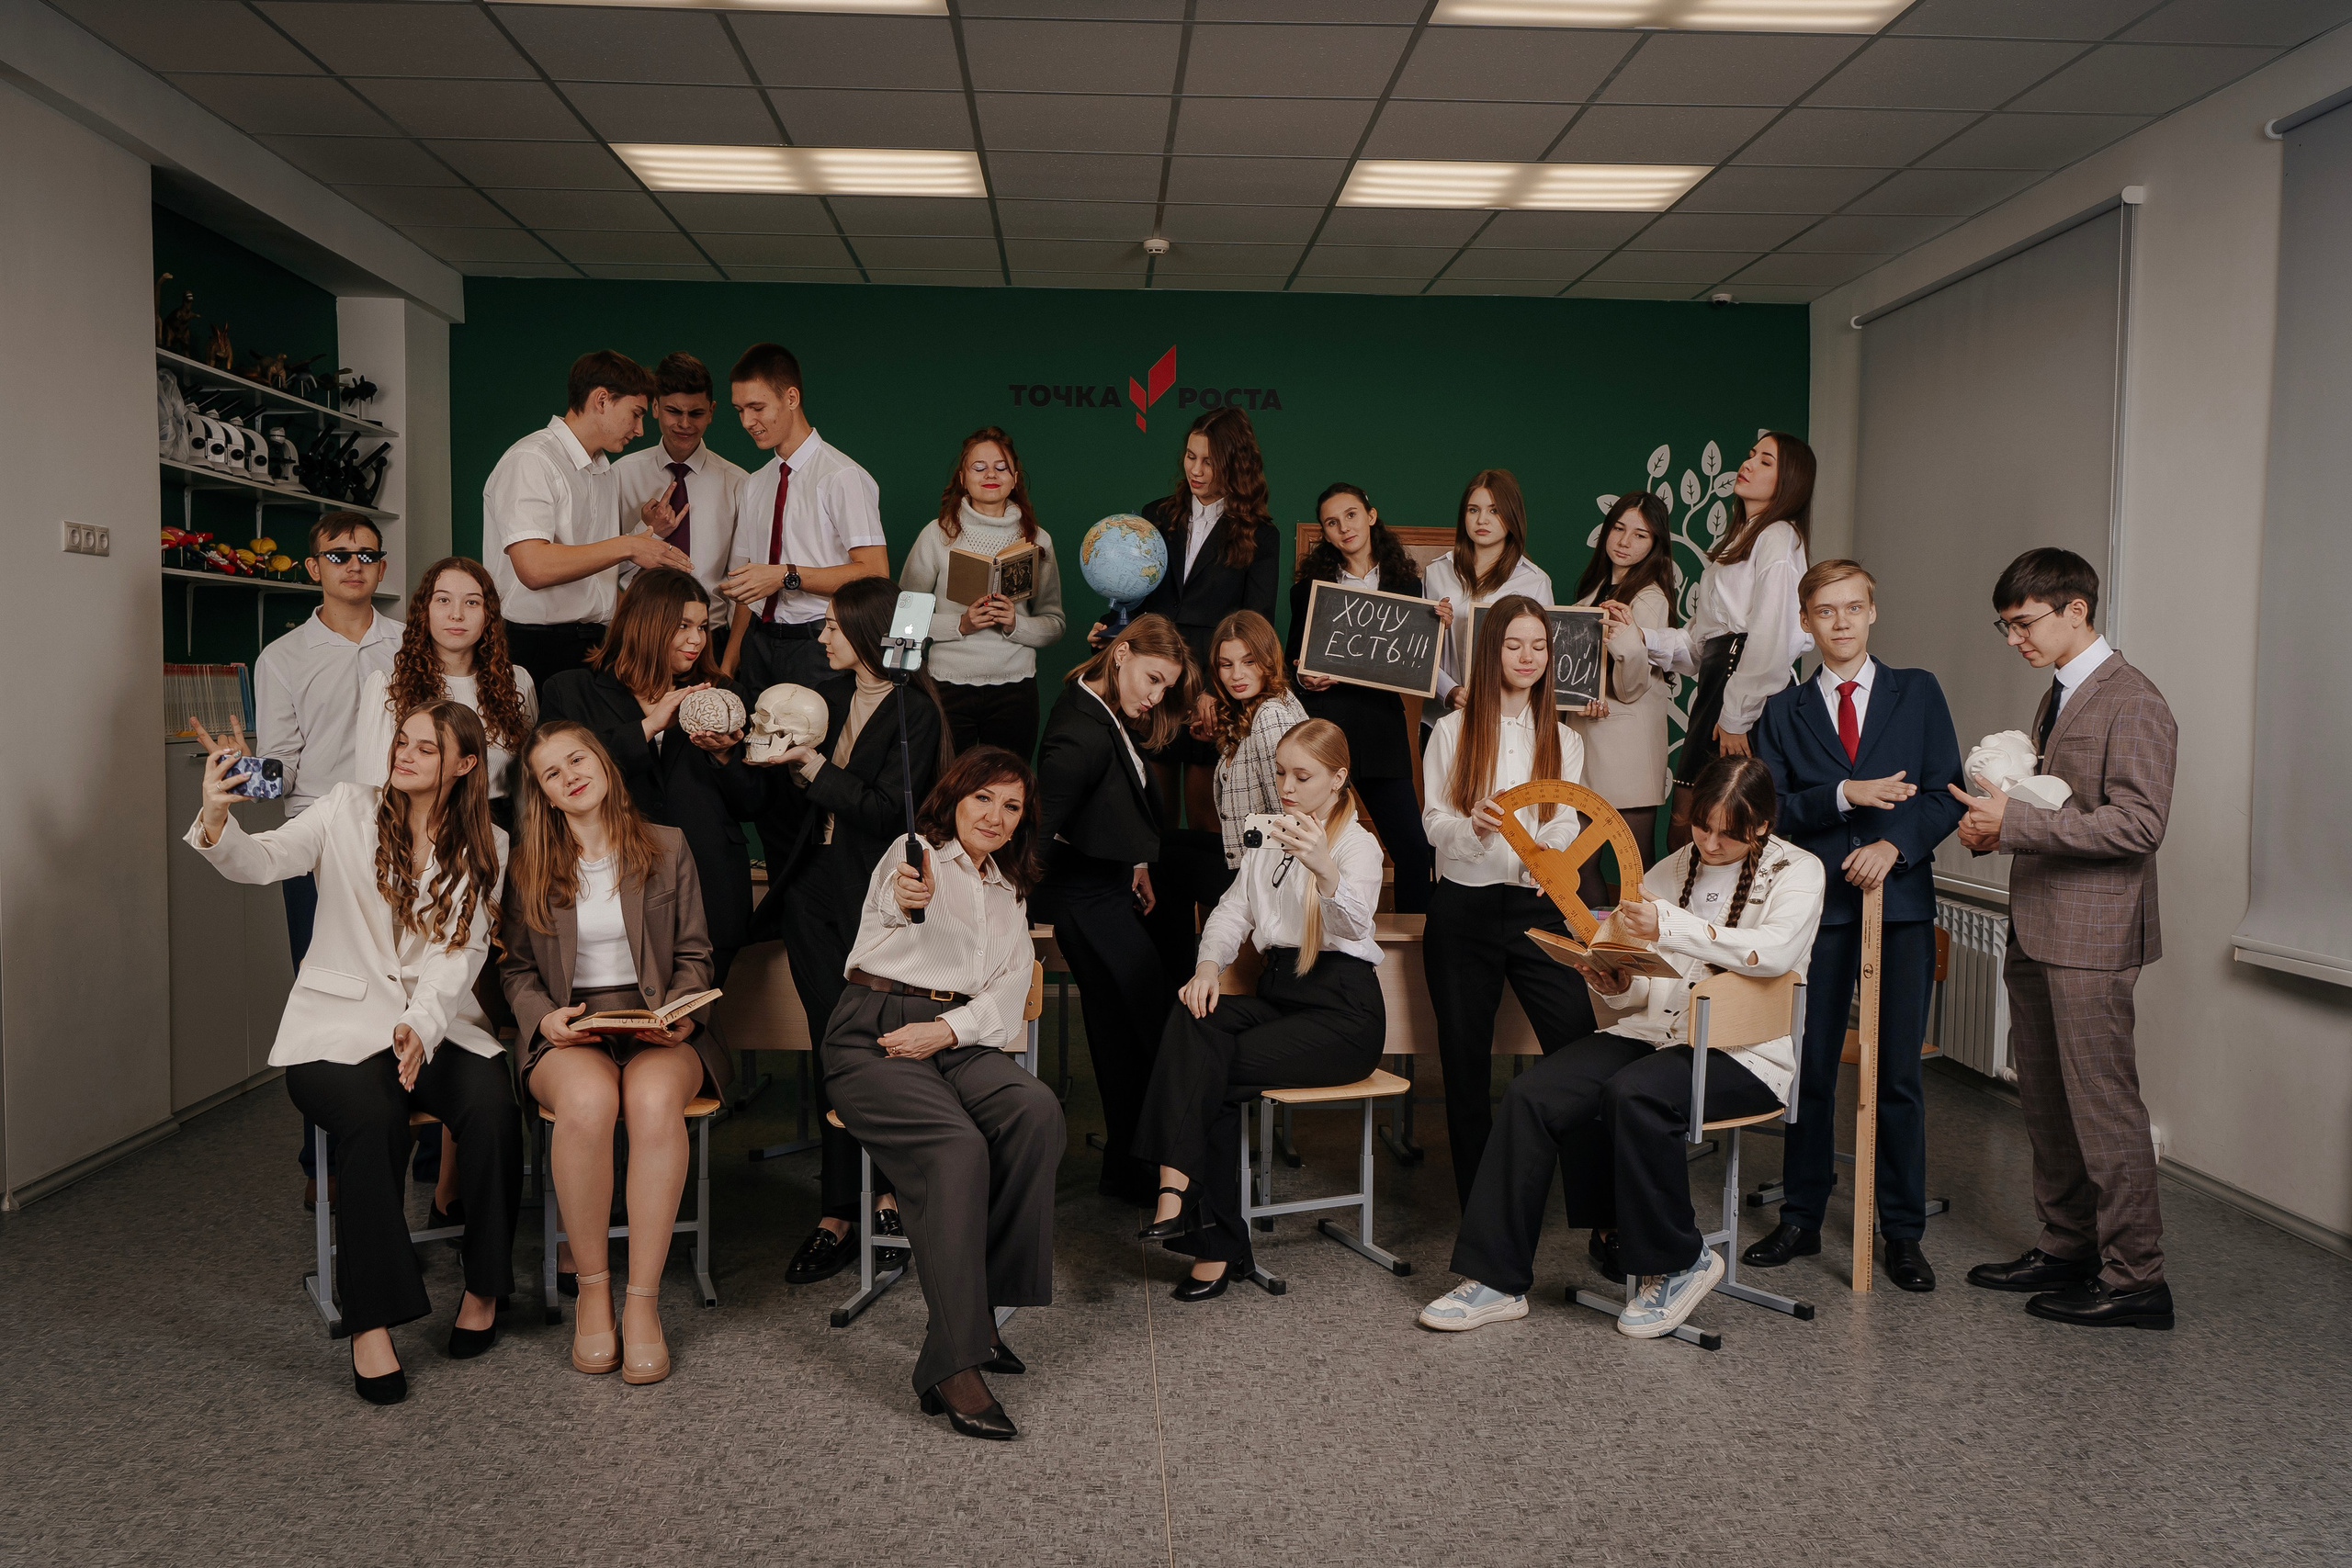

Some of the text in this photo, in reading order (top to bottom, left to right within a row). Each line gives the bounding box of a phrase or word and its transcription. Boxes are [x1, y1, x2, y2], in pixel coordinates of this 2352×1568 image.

[1009, 384, 1283, 411] ТОЧКА РОСТА
[1332, 595, 1410, 633] ХОЧУ
[1324, 631, 1430, 669] ЕСТЬ!!!
[1553, 639, 1600, 692] ОЙ!
